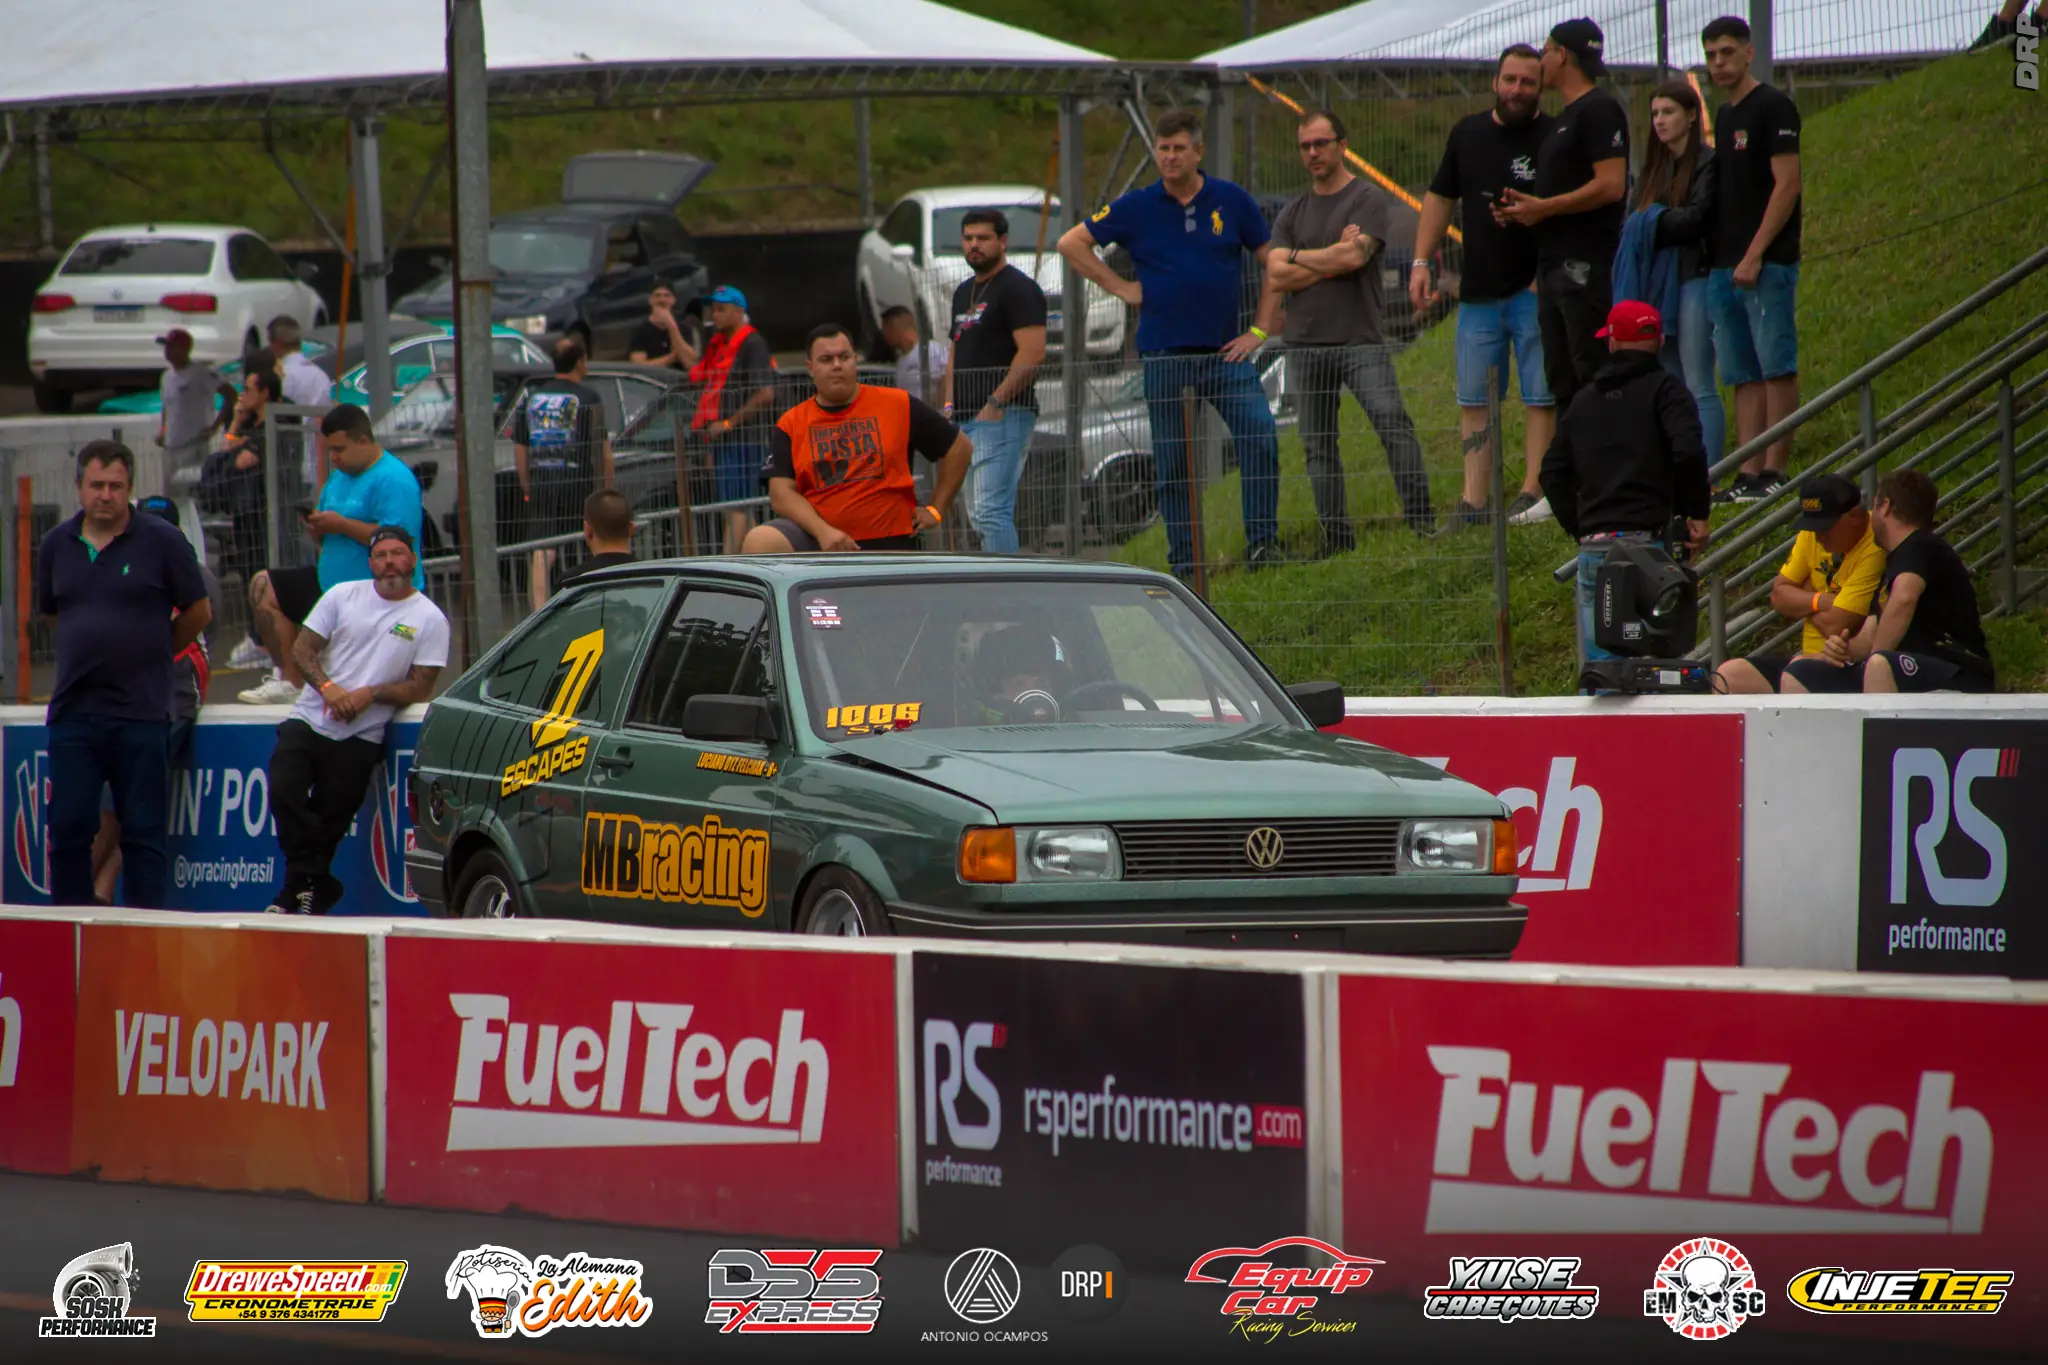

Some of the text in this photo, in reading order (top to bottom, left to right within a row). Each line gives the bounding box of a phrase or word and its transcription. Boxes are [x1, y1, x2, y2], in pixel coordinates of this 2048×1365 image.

[817, 433, 877, 461] PISTA
[826, 702, 922, 728] 1006
[501, 735, 590, 797] ESCAPES
[174, 855, 274, 889] @vpracingbrasil
[583, 815, 767, 915] MBracing
[1888, 917, 2007, 955] performance
[115, 1009, 329, 1110] VELOPARK
[448, 993, 830, 1144] FuelTech
[1427, 1045, 1994, 1234] FuelTech
[926, 1155, 1002, 1187] performance
